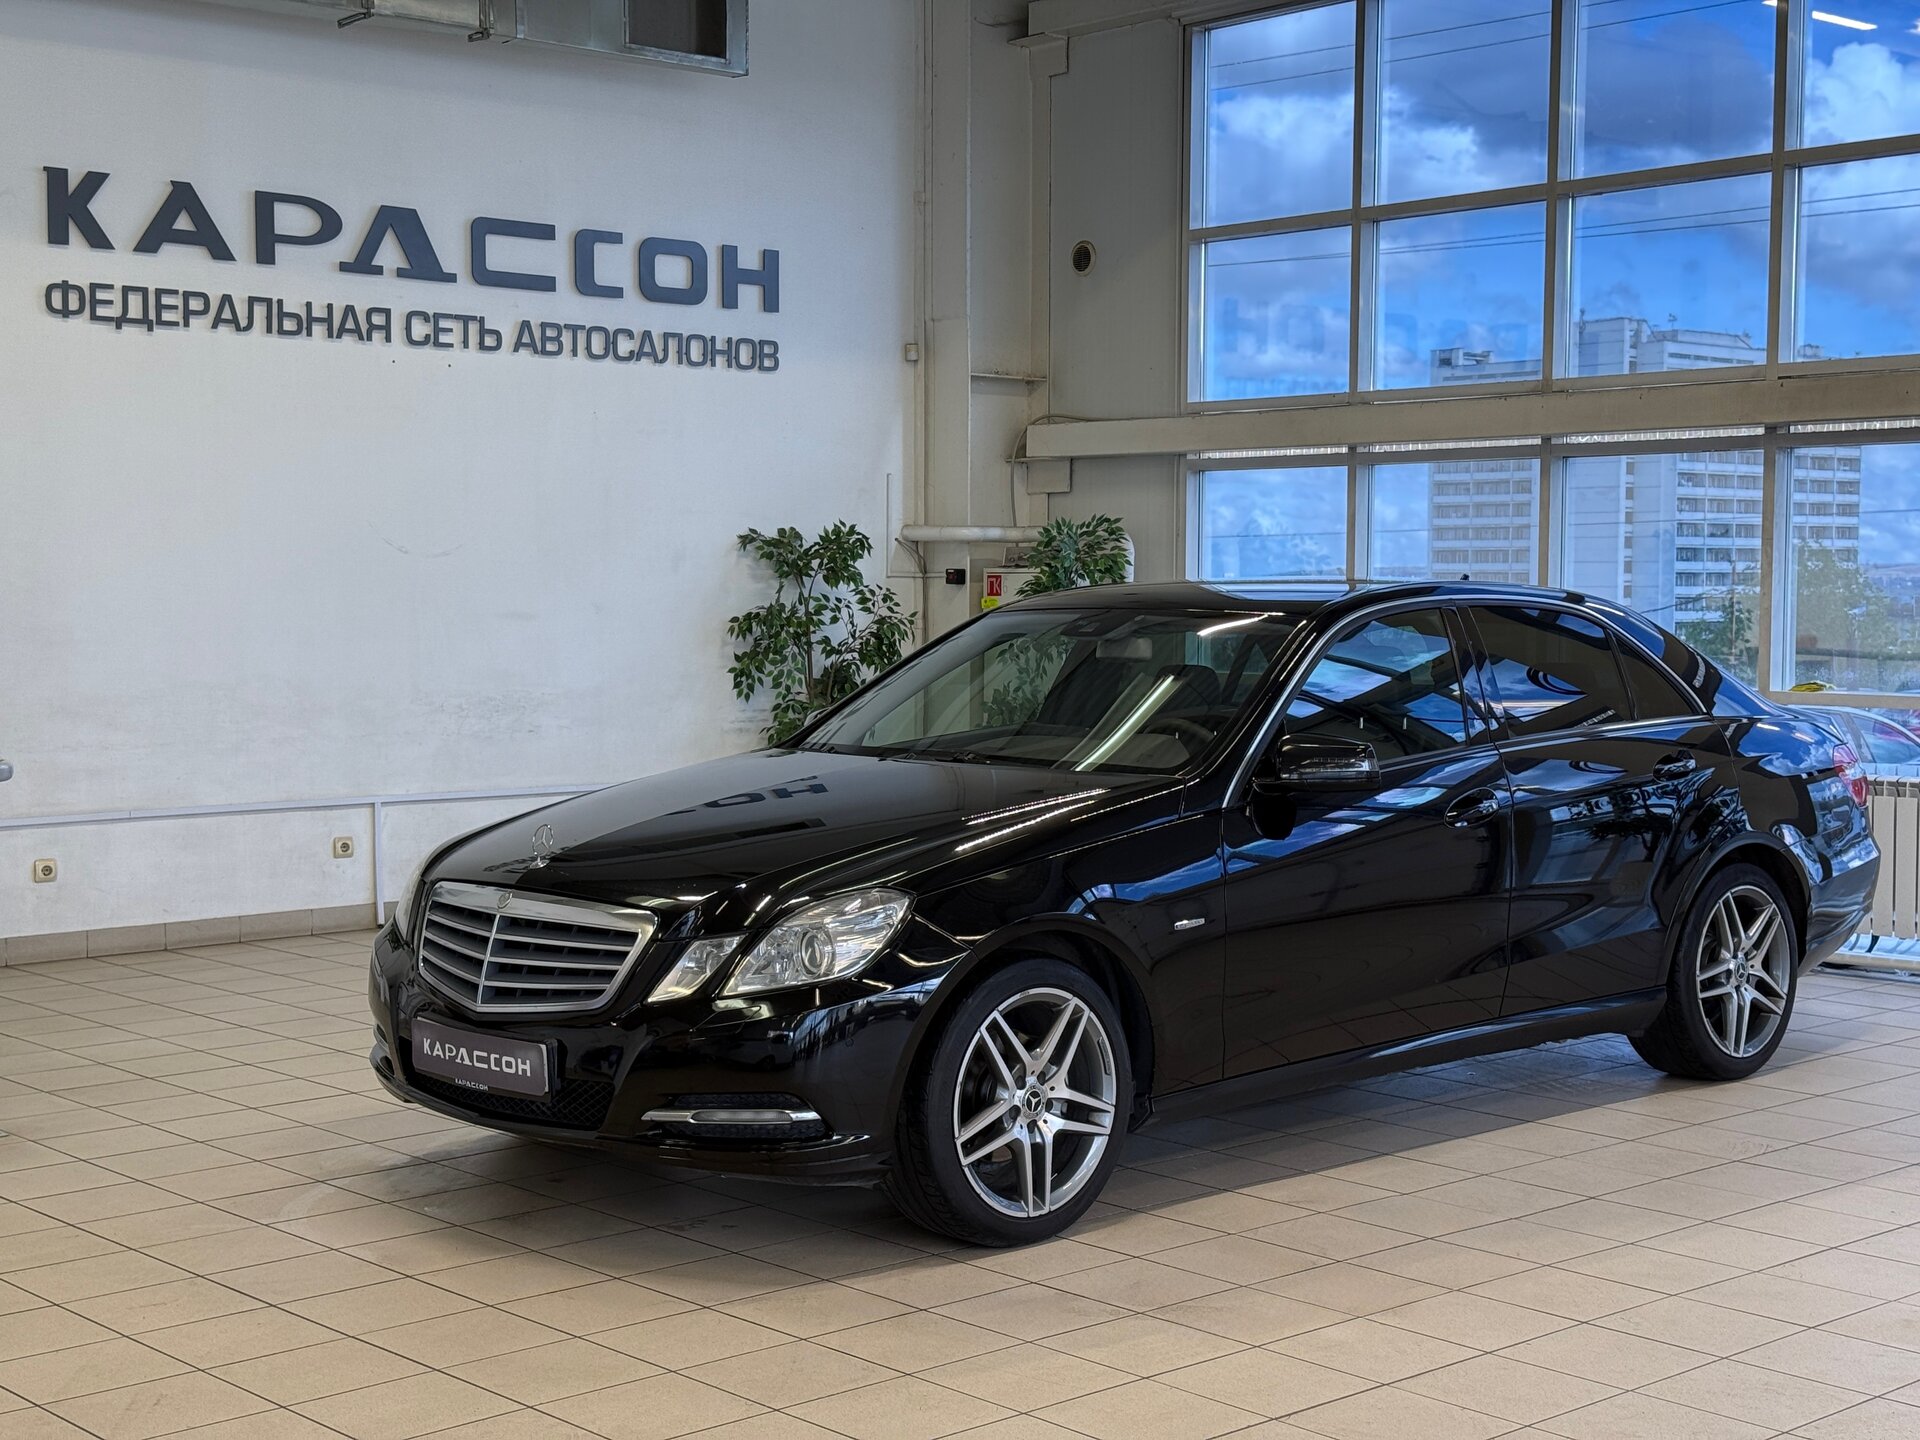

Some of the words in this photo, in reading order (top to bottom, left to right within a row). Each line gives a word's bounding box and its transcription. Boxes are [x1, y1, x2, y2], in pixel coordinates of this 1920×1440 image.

[44, 279, 392, 343] ФЕДЕРАЛЬНАЯ
[404, 310, 503, 352] СЕТЬ
[512, 319, 780, 372] АВТОСАЛОНОВ
